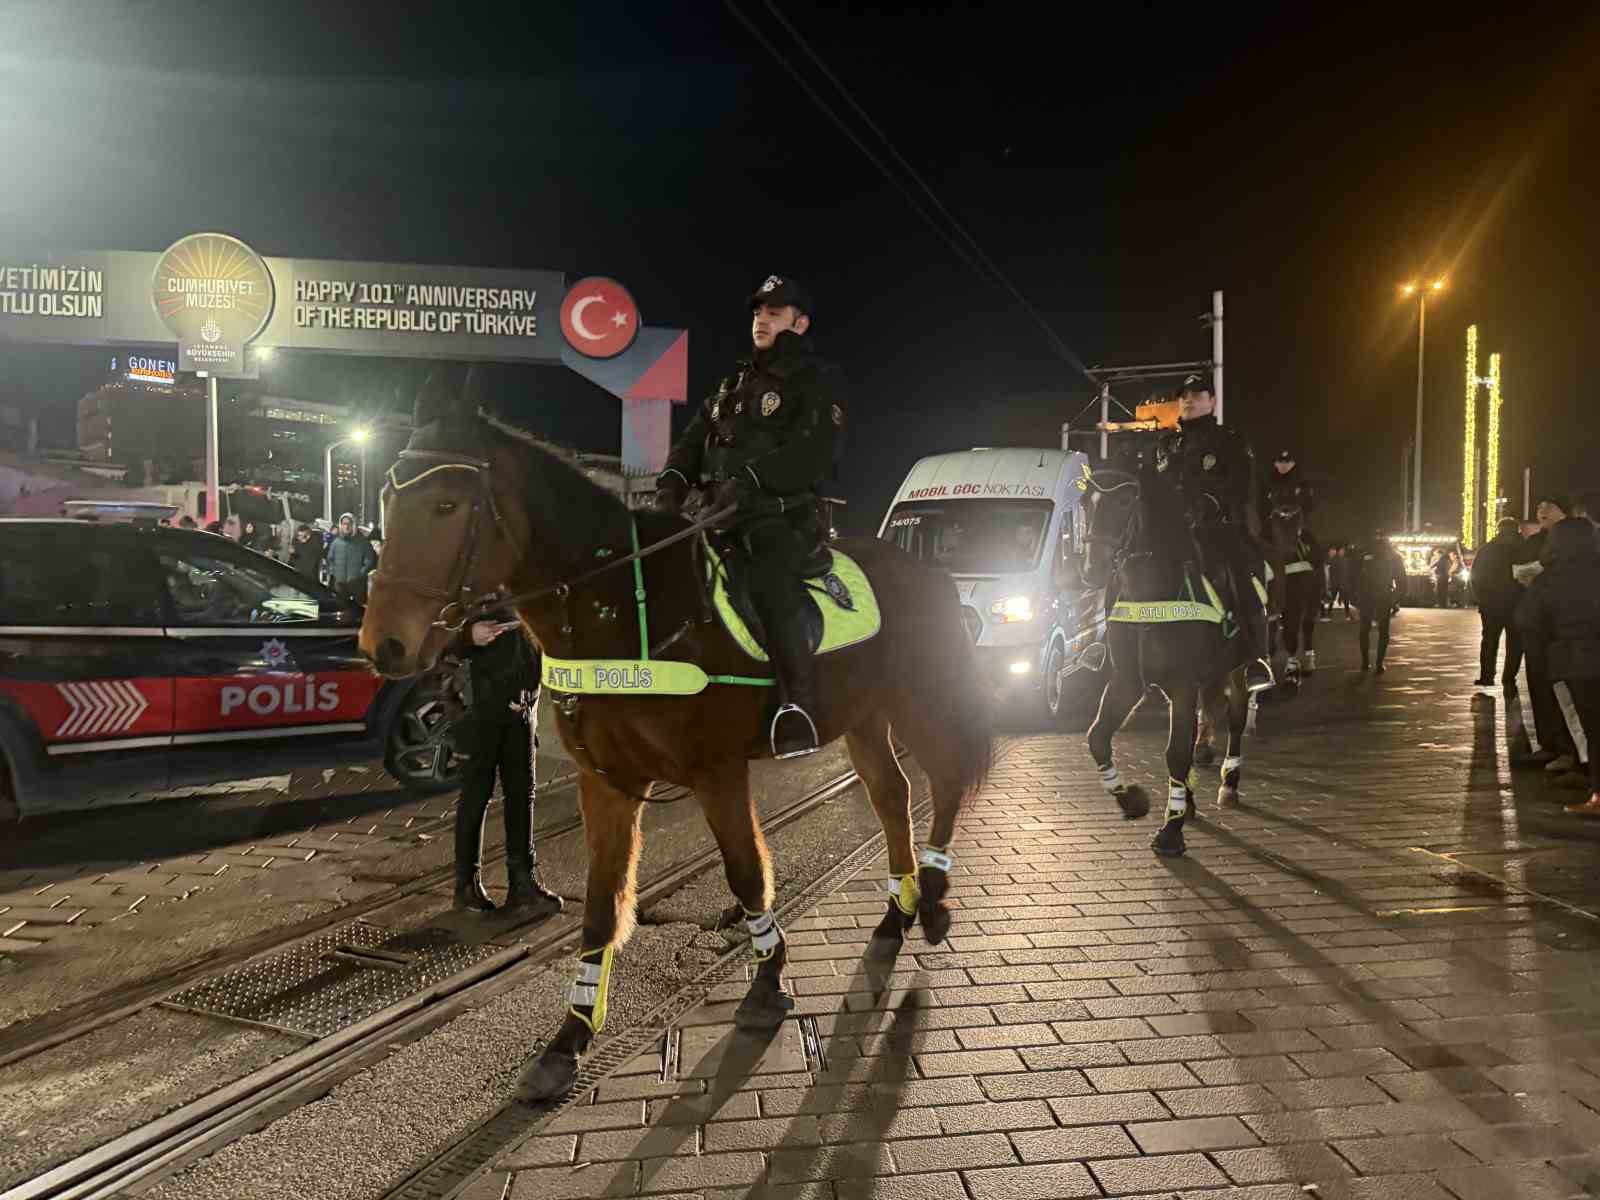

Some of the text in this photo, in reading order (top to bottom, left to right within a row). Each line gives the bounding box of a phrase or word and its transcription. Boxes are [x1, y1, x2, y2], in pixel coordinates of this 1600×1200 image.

[39, 293, 103, 318] OLSUN
[295, 279, 356, 303] HAPPY
[406, 284, 537, 311] ANNIVERSARY
[295, 304, 537, 337] OF THE REPUBLIC OF TÜRKİYE
[548, 663, 652, 688] ATLI POLİS
[220, 674, 340, 716] POLİS
